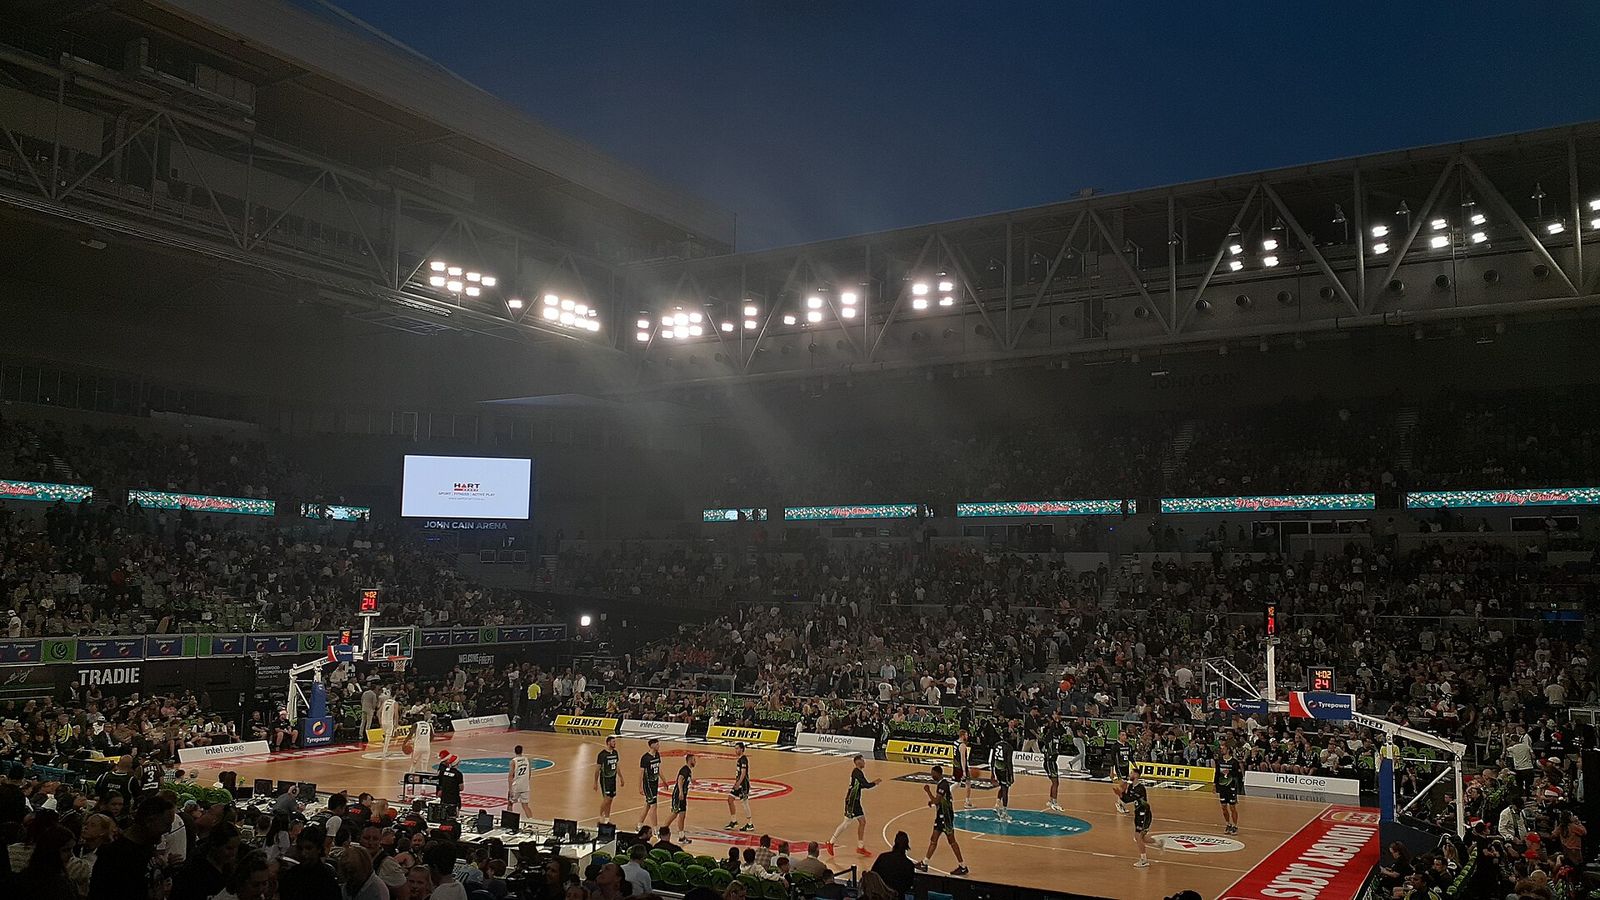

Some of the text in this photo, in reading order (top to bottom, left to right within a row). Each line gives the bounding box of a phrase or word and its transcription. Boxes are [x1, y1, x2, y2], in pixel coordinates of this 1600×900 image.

[1495, 492, 1568, 504] Merry Christmas
[1235, 498, 1296, 511] Merry Christmas
[424, 521, 450, 529] JOHN
[362, 598, 375, 610] 24
[78, 667, 140, 686] TRADIE
[1315, 670, 1332, 679] 4:02
[1314, 679, 1329, 690] 24
[1318, 701, 1350, 709] Tyrepower
[567, 718, 580, 726] JB
[722, 728, 736, 737] JB
[205, 746, 222, 754] intel
[904, 744, 921, 753] JB
[1015, 753, 1033, 761] intel
[147, 771, 154, 782] 3
[518, 768, 526, 776] 22
[1276, 774, 1297, 784] intel
[1298, 824, 1378, 867] HUNGRY
